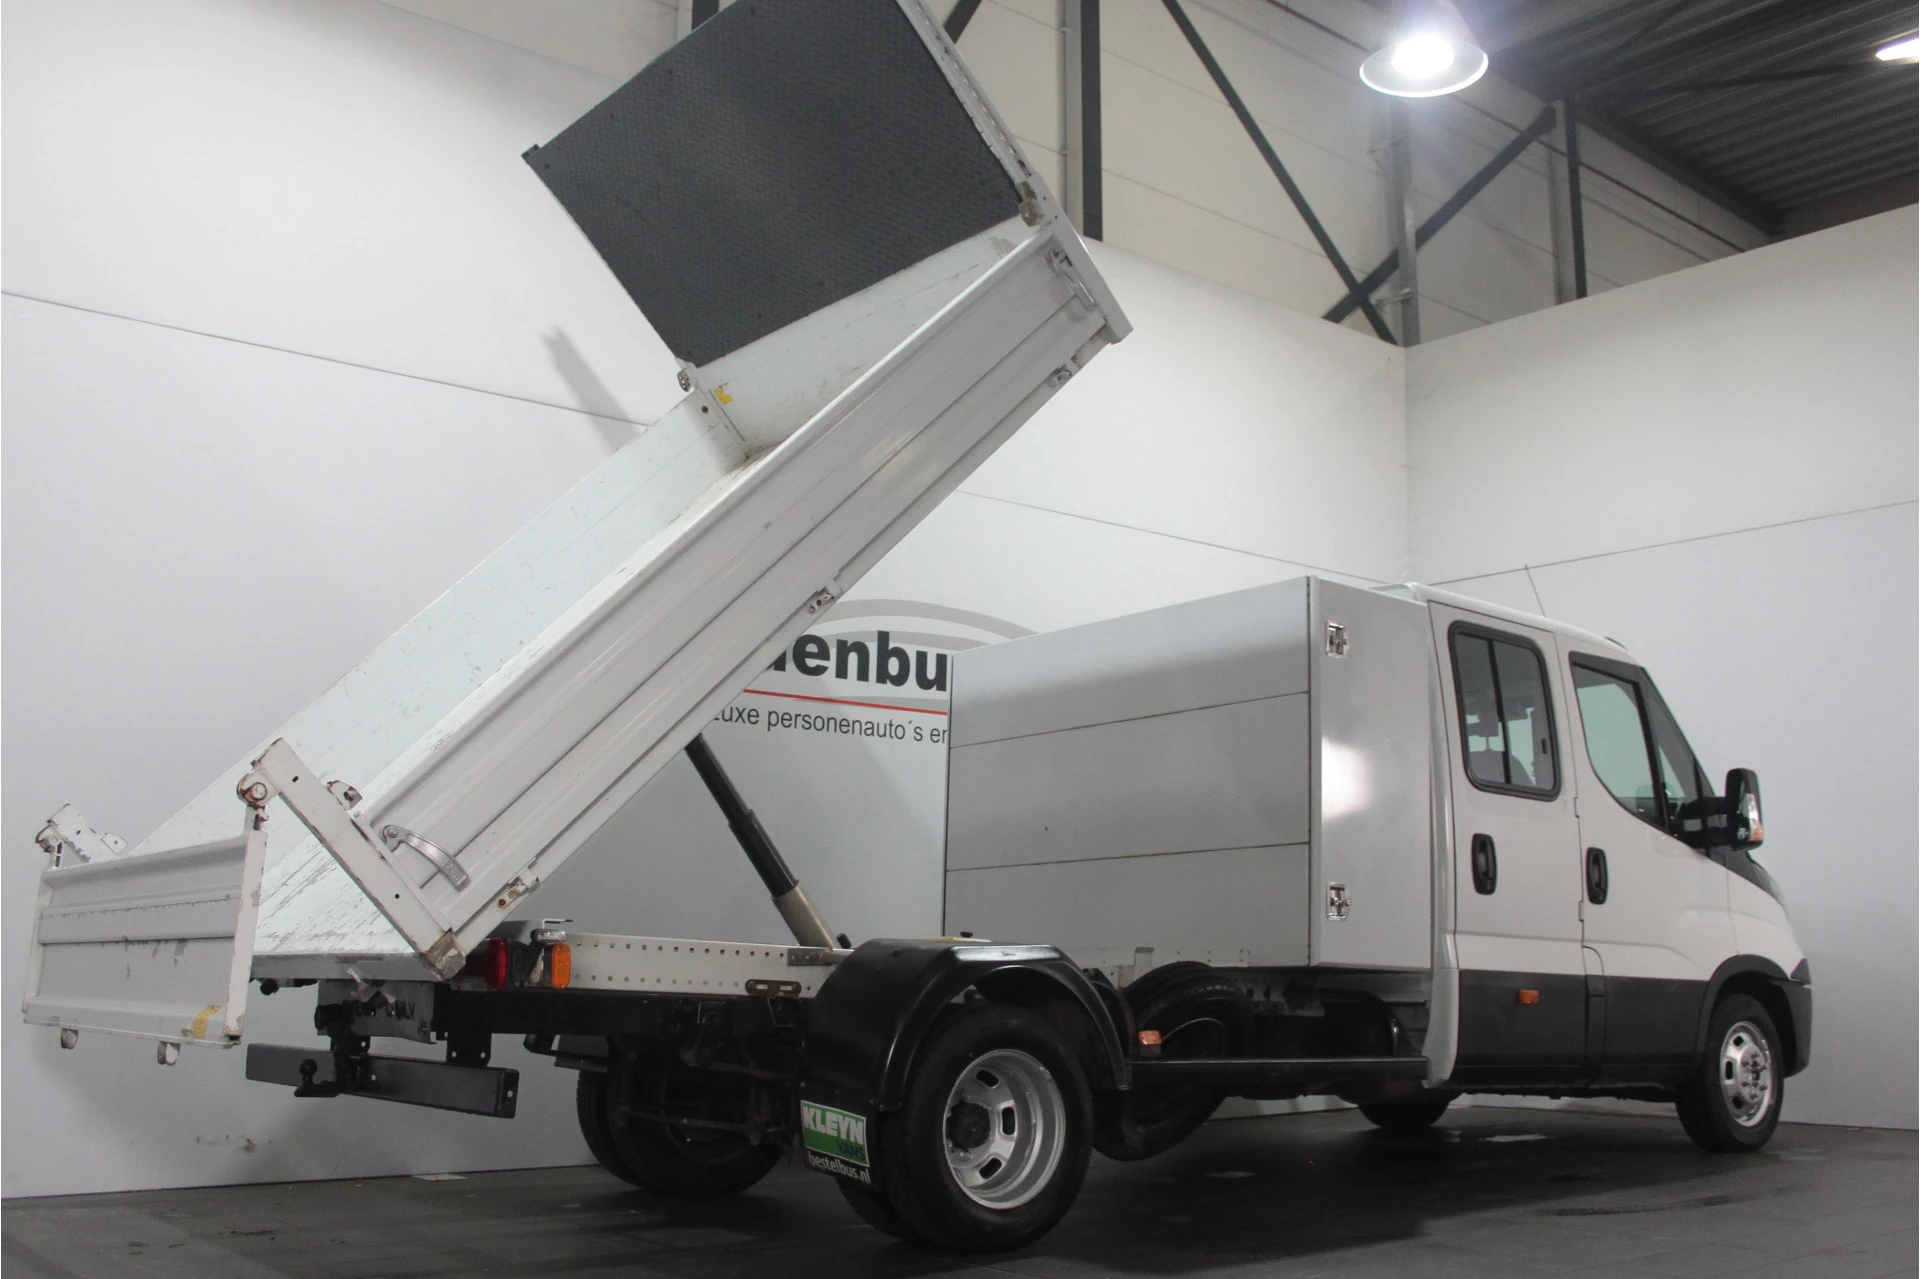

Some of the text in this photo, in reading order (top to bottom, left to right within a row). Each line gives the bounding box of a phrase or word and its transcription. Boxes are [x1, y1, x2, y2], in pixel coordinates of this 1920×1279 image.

[766, 630, 948, 692] enbu
[714, 706, 760, 725] uxe
[802, 1106, 863, 1145] KLEYN
[807, 1150, 871, 1184] bestelbus.nl
